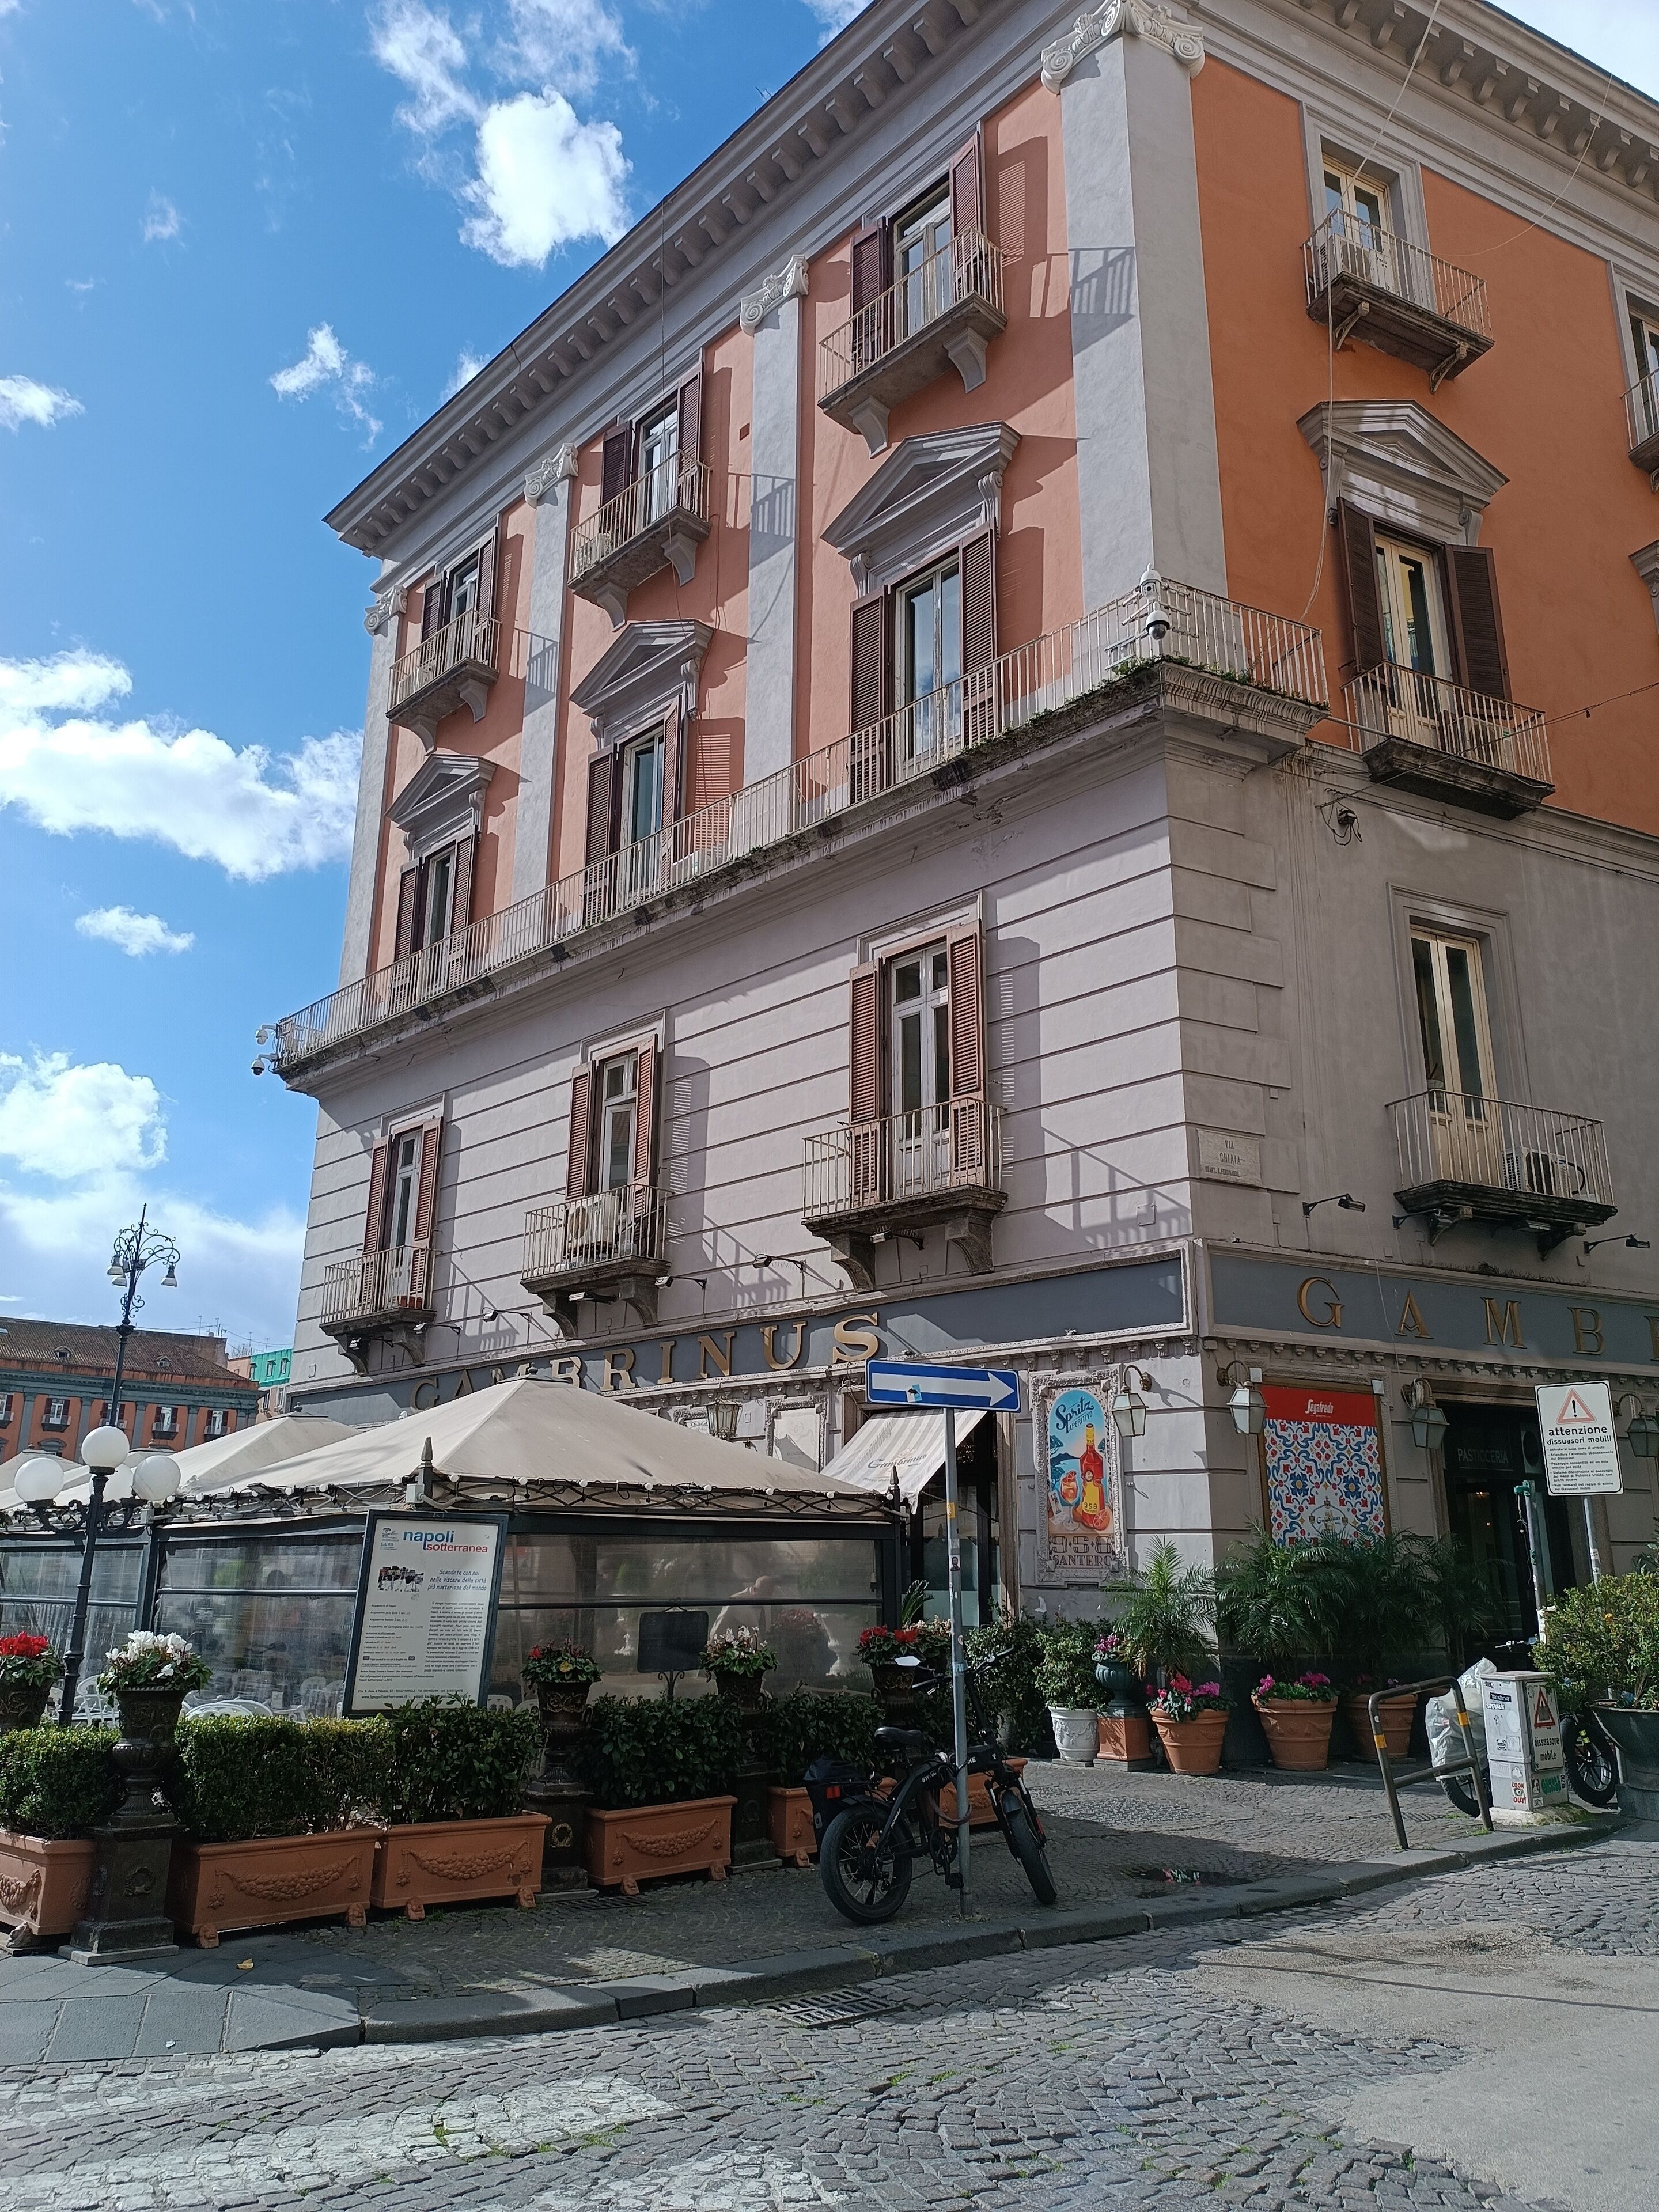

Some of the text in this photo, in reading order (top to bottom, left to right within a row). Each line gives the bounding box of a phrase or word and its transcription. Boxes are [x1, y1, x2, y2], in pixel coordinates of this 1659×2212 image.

[1225, 1140, 1234, 1149] VIA
[1220, 1152, 1241, 1165] CHIAIA
[1305, 1399, 1334, 1414] Segafredo
[1055, 1396, 1094, 1434] Spritz
[1069, 1411, 1093, 1431] APERITIVO
[1548, 1426, 1607, 1436] attenzione
[868, 1453, 928, 1469] Gambrinus
[1457, 1448, 1508, 1464] PASTICCERIA
[1084, 1502, 1098, 1510] 958
[403, 1530, 454, 1551] napoli
[426, 1543, 488, 1553] sotterranea
[1052, 1555, 1113, 1566] SANTERO
[1534, 1737, 1559, 1747] dissuasore
[1540, 1749, 1556, 1761] mobile
